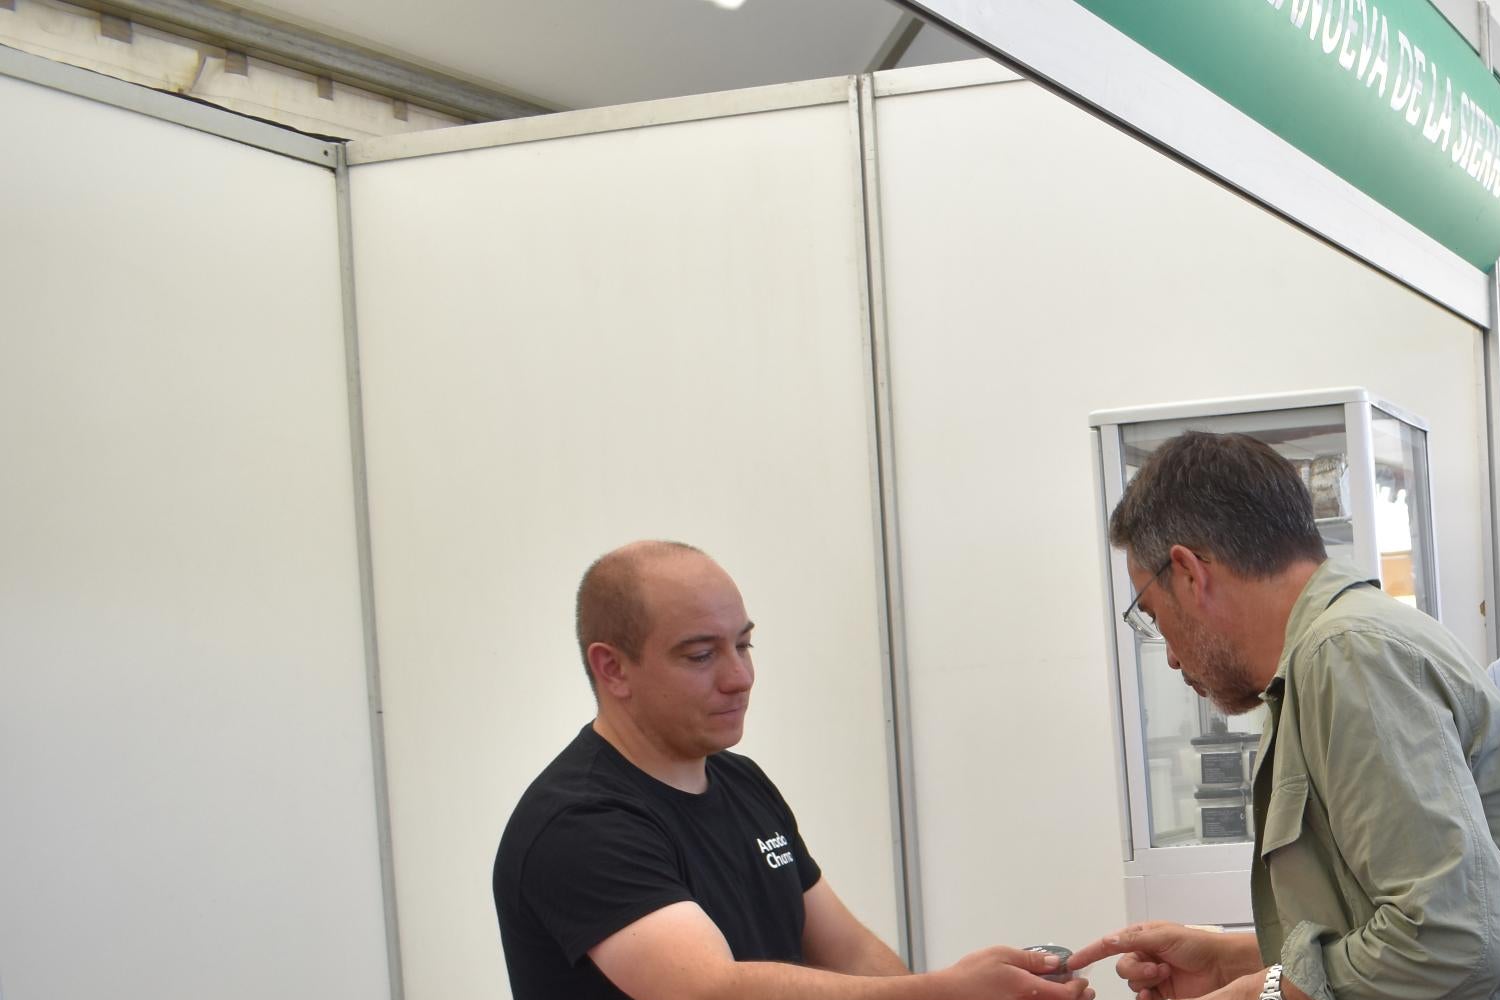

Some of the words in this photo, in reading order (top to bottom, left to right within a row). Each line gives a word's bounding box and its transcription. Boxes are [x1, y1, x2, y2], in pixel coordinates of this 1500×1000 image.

[1266, 0, 1389, 99] NUEVA
[1390, 30, 1425, 126] DE
[1422, 62, 1453, 152] LA
